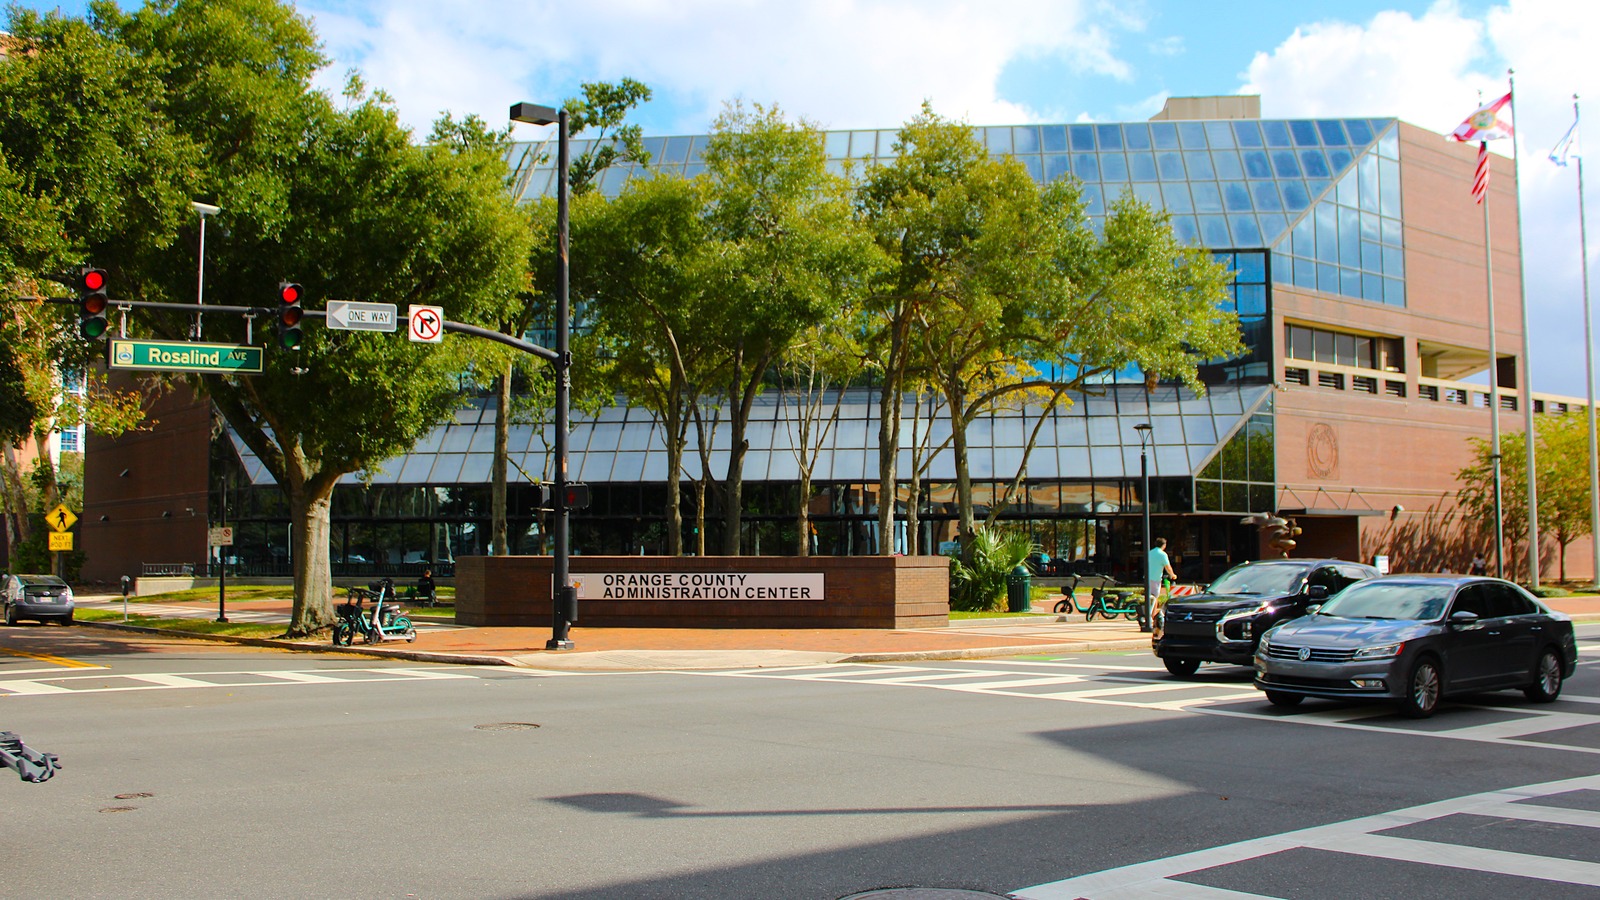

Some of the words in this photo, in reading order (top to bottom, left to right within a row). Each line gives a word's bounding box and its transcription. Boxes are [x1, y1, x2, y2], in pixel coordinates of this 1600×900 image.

[348, 310, 366, 321] ONE
[371, 312, 390, 323] WAY
[148, 348, 219, 365] Rosalind
[227, 352, 247, 361] AVE
[604, 575, 672, 586] ORANGE
[679, 575, 746, 586] COUNTY
[603, 587, 739, 598] ADMINISTRATION
[746, 587, 811, 598] CENTER
